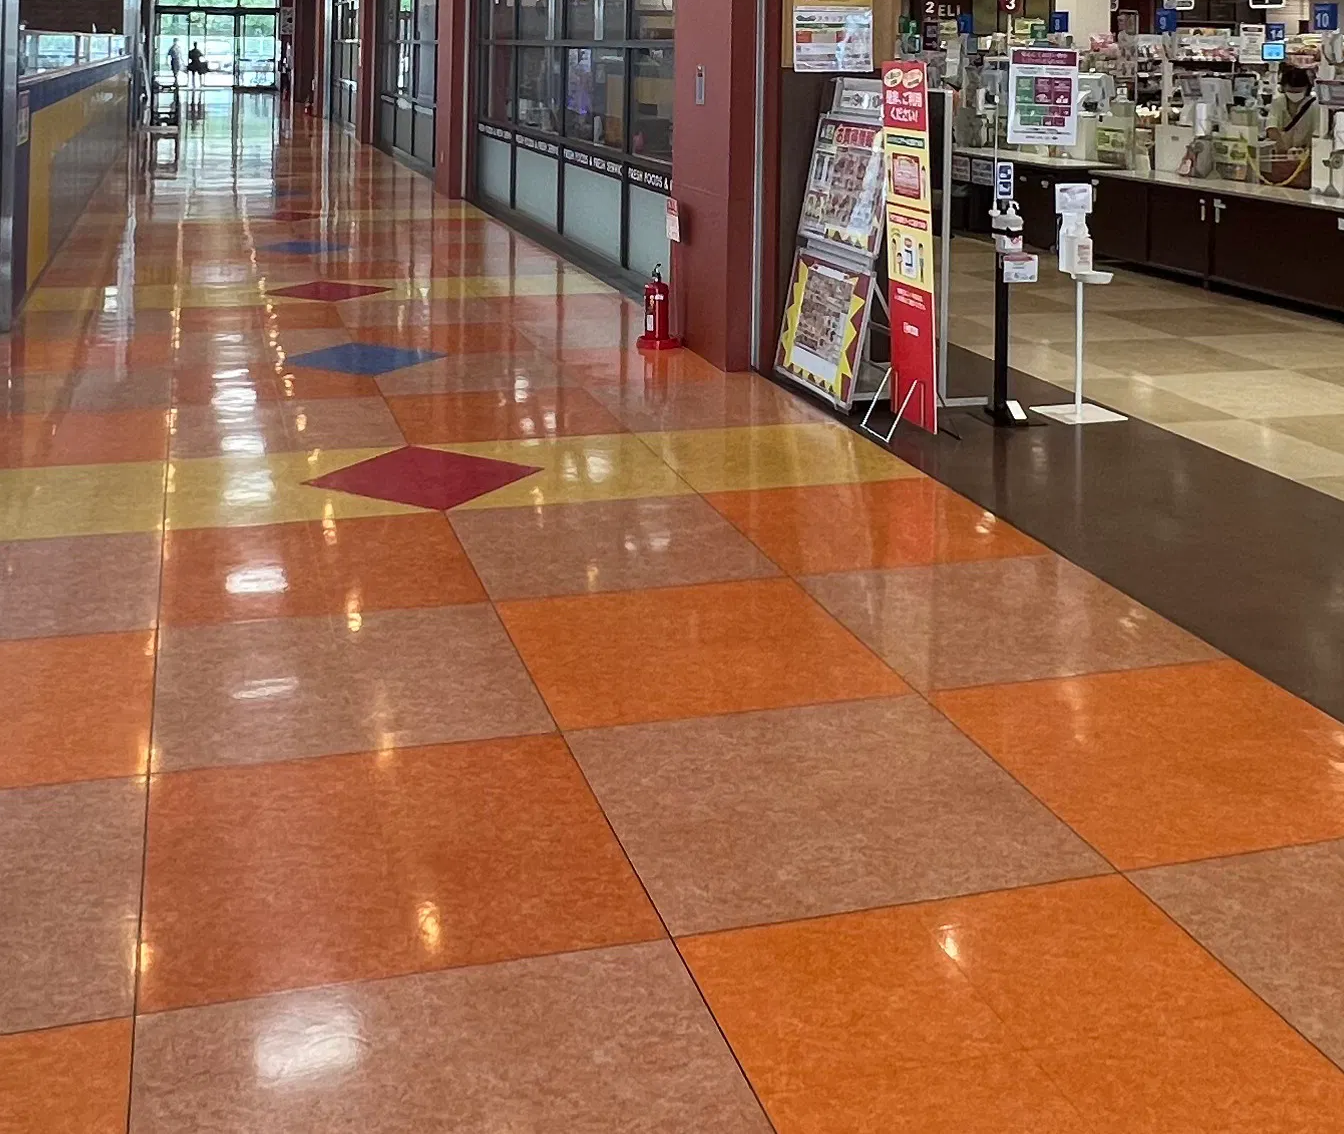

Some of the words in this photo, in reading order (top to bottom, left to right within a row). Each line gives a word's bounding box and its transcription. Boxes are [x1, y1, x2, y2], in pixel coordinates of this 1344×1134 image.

[925, 1, 935, 14] 2
[1159, 16, 1167, 30] 9
[1315, 13, 1329, 28] 10
[1270, 30, 1284, 41] 14
[628, 166, 643, 182] FRESH
[644, 171, 663, 188] FOODS
